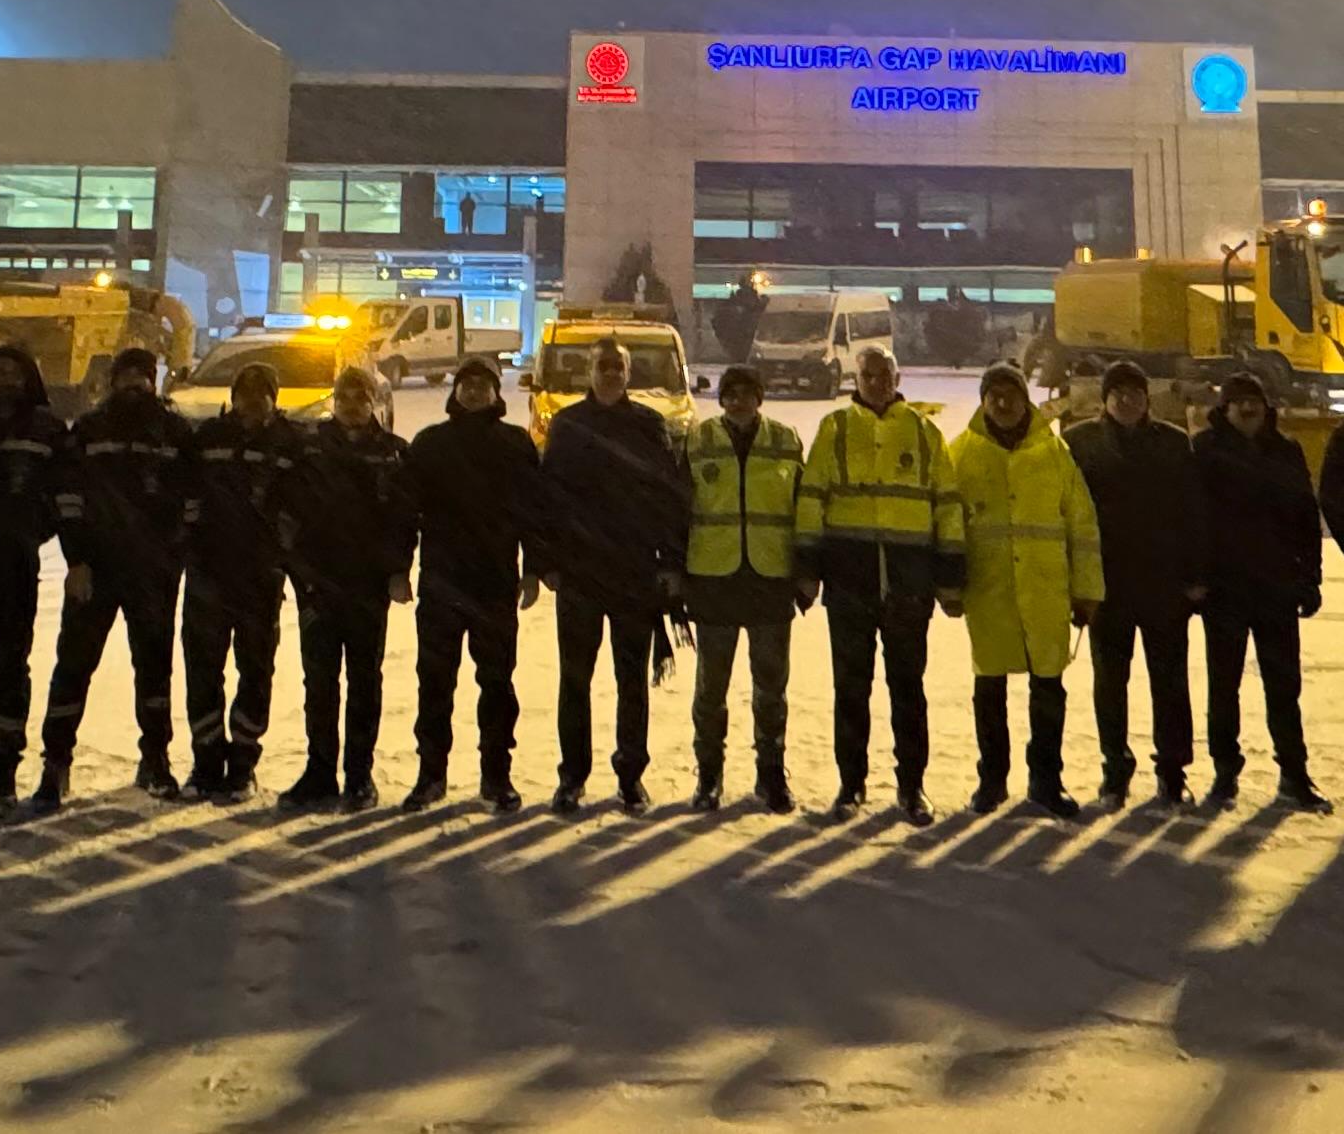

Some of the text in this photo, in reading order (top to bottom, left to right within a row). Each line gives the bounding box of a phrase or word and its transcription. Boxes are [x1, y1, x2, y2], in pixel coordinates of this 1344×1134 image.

[708, 43, 1127, 74] ŞANLIURFA GAP HAVALİMANI
[852, 87, 981, 109] AIRPORT
